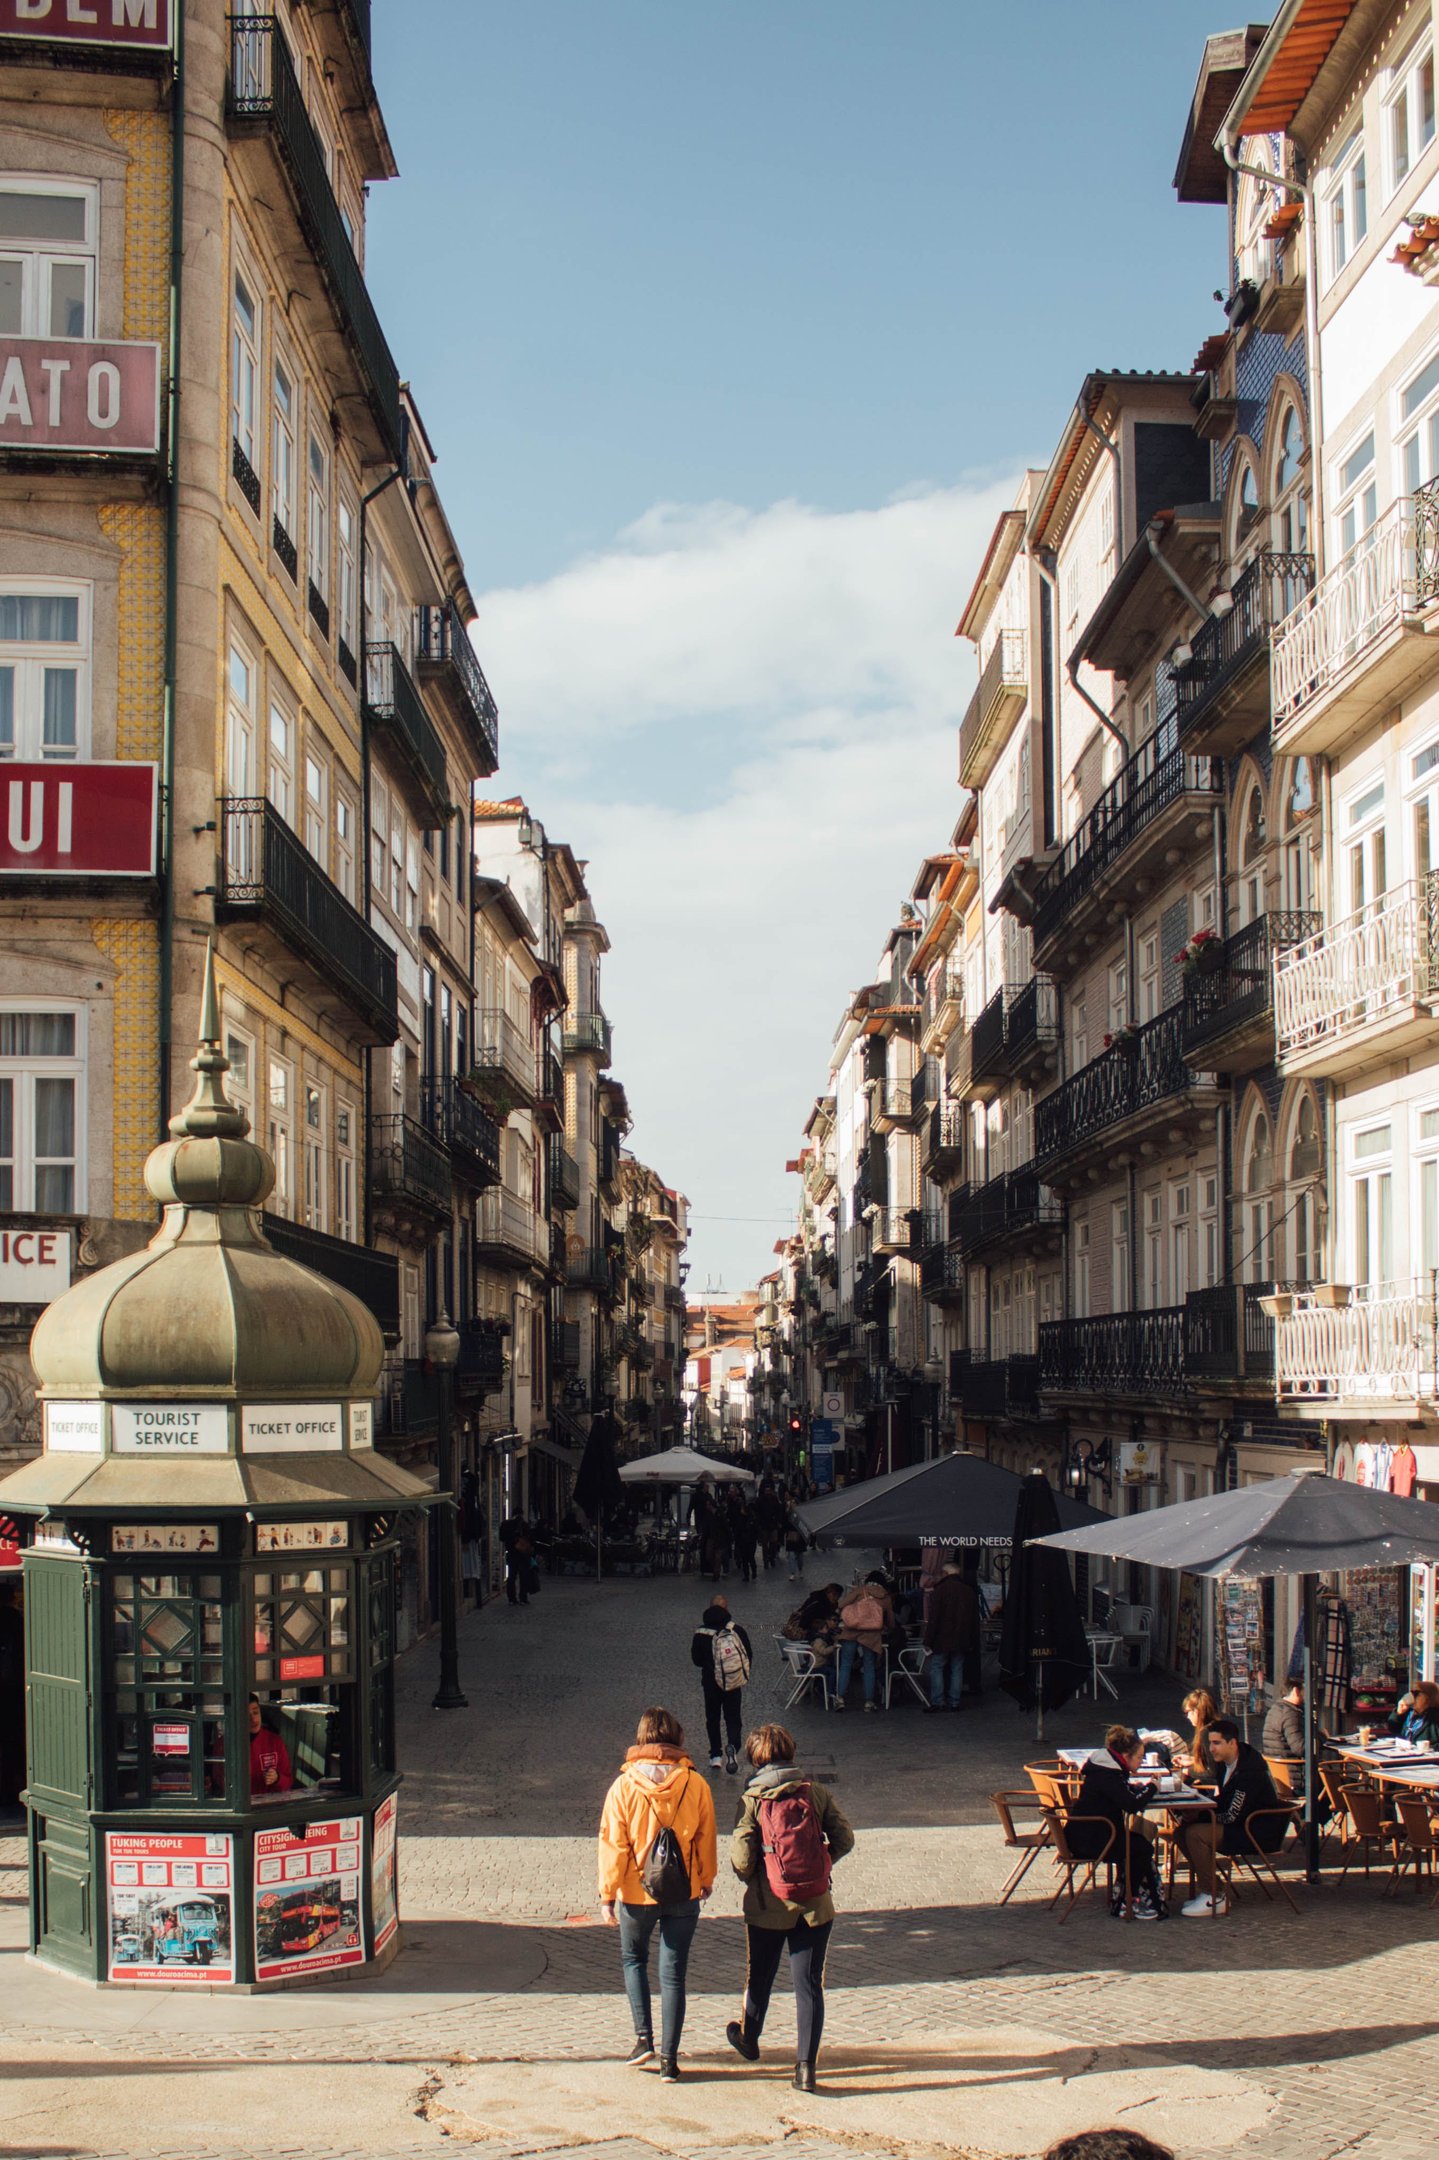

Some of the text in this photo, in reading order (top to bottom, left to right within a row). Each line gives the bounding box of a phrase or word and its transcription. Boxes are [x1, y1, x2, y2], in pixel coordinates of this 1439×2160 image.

[8, 780, 73, 853] UI
[2, 1232, 57, 1265] ICE
[133, 1412, 201, 1426] TOURIST
[51, 1422, 98, 1434] TICKET OFFICE
[248, 1421, 337, 1435] TICKET OFFICE
[135, 1431, 199, 1445] SERVICE
[918, 1536, 1013, 1547] THE WORLD NEEDS
[111, 1838, 183, 1849] TUKING PEOPLE
[259, 1845, 271, 1853] CITY
